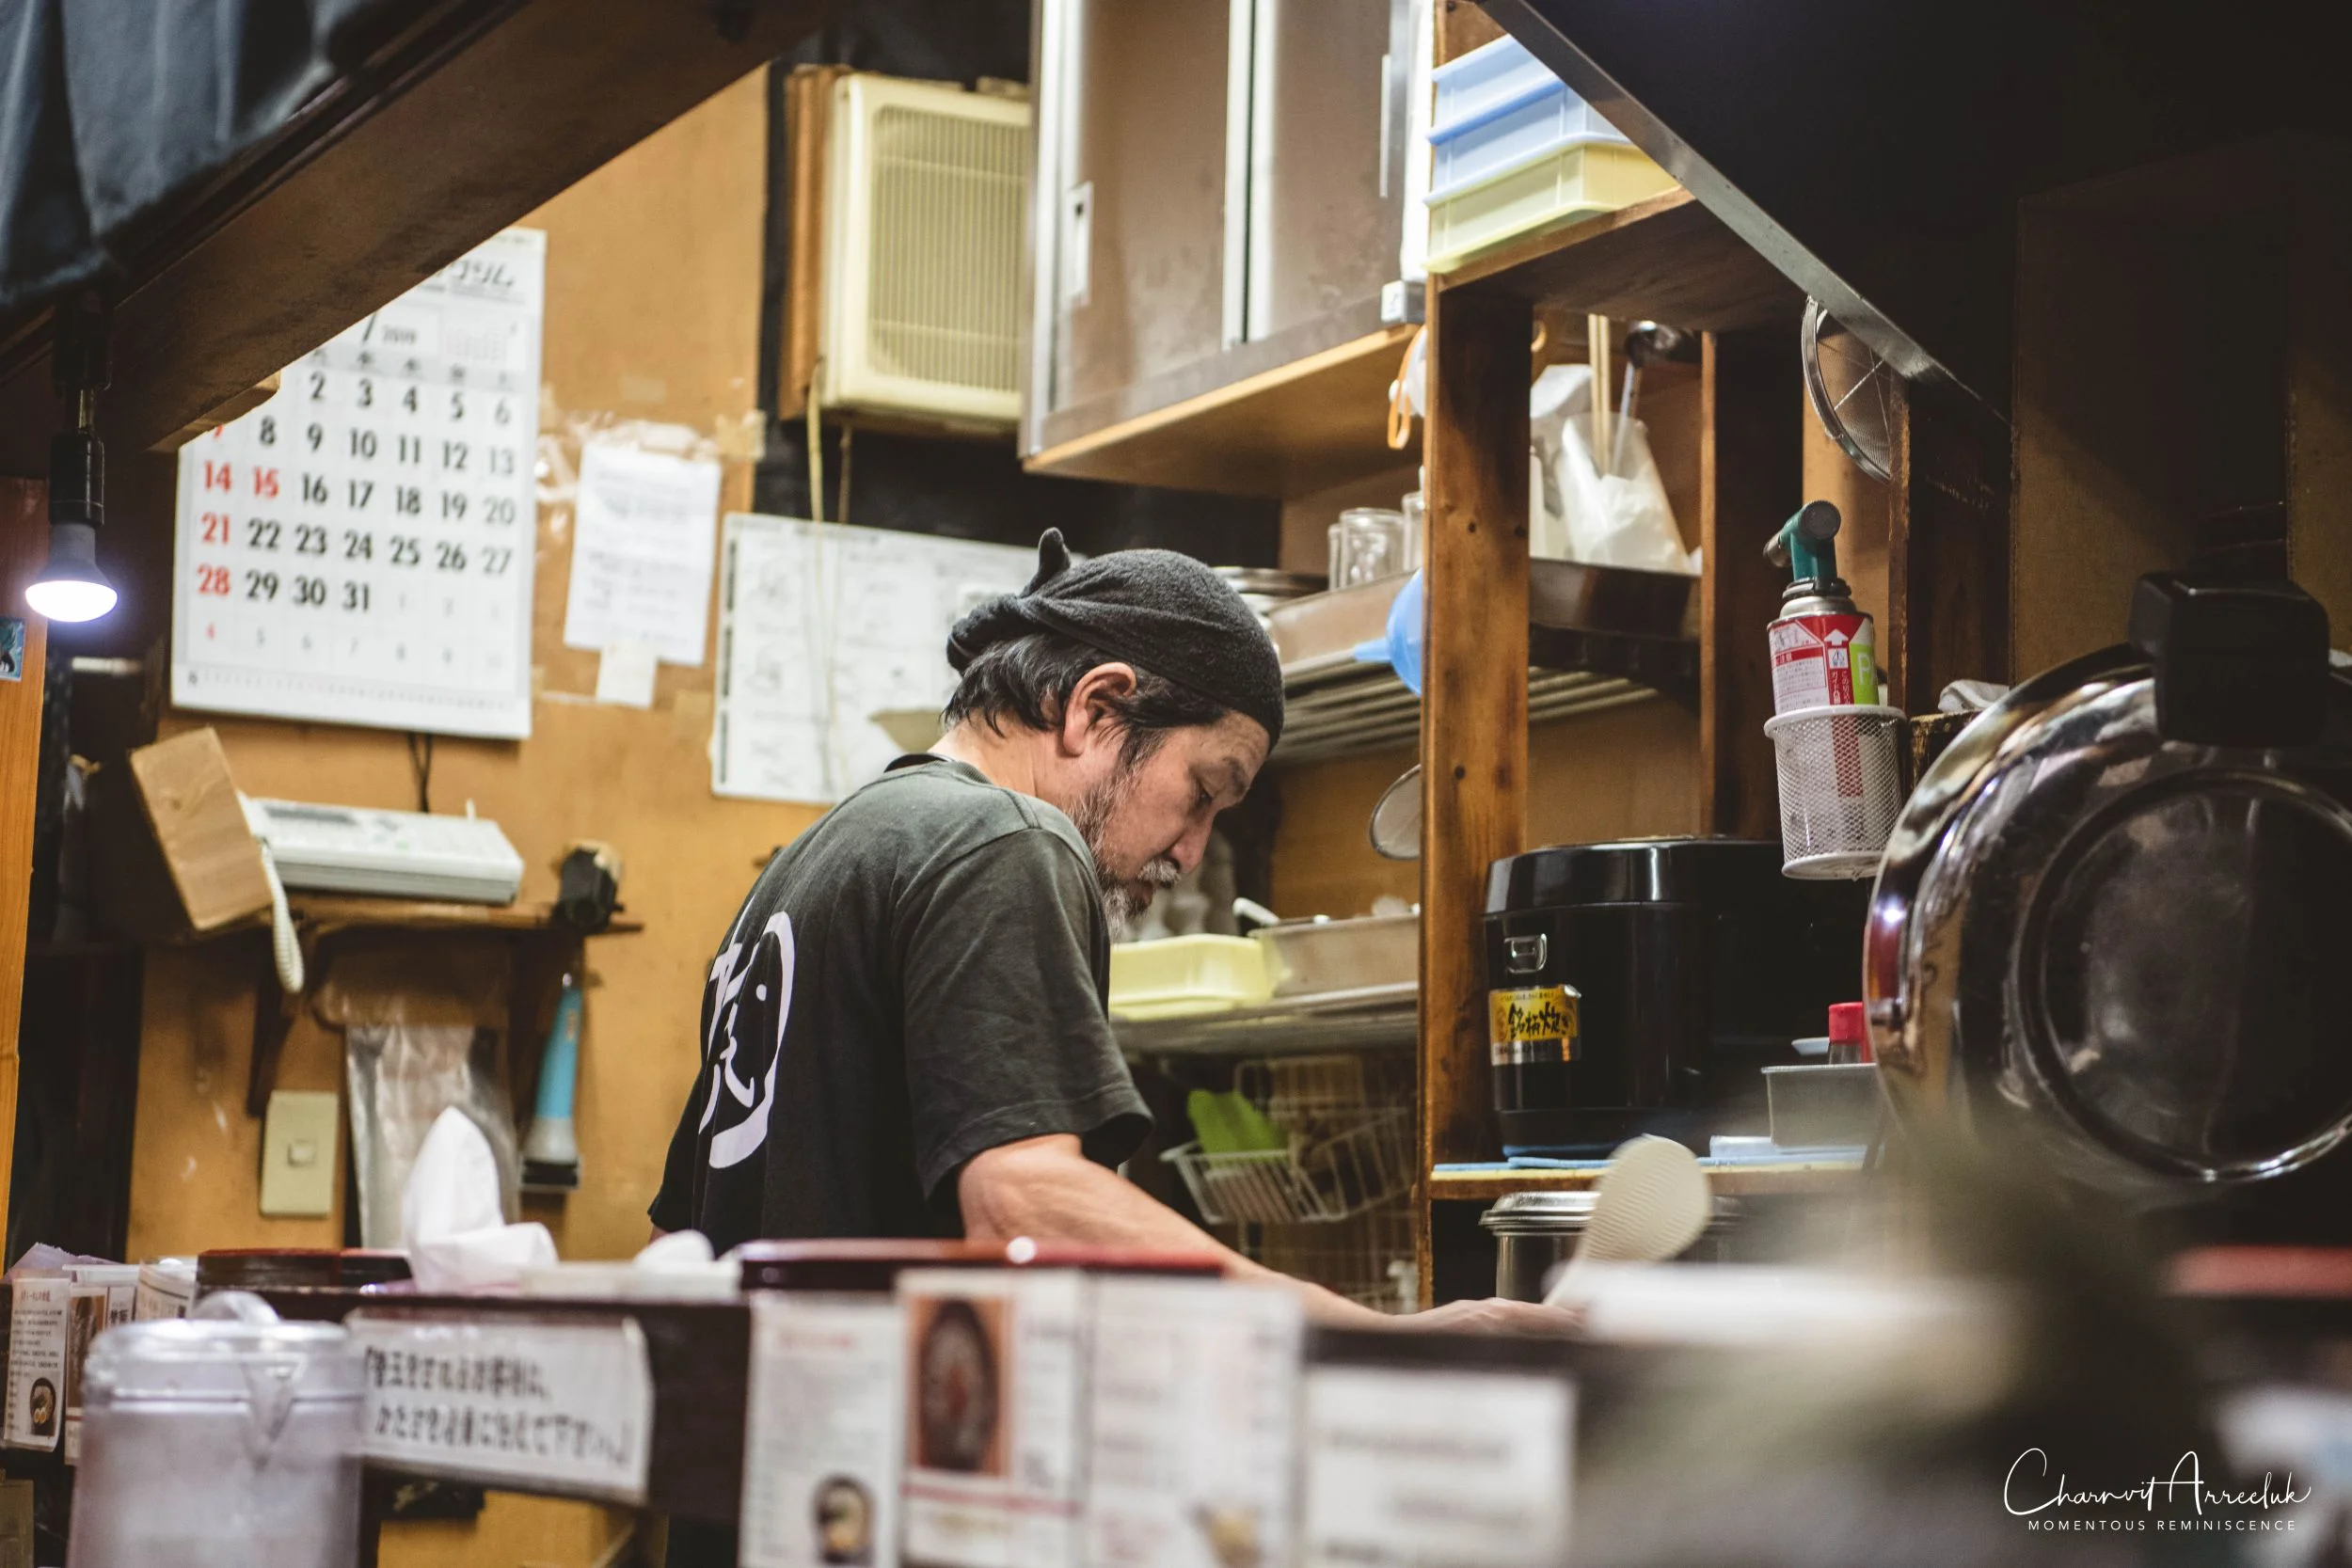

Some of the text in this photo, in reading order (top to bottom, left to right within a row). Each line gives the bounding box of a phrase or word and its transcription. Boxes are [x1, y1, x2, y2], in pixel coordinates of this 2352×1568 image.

[310, 372, 512, 426] 2 3 4 5 6
[259, 416, 277, 447] 8
[307, 423, 324, 451] 9
[350, 428, 378, 460] 10
[399, 435, 421, 465] 11
[442, 440, 469, 471] 12
[489, 446, 516, 478] 13
[205, 461, 516, 527] 14 15 16 17 18 19 20
[201, 512, 513, 576] 21 22 23 24 25 26 27
[197, 564, 231, 596] 28
[246, 570, 279, 601] 29
[294, 576, 327, 607] 30
[343, 581, 370, 611] 31
